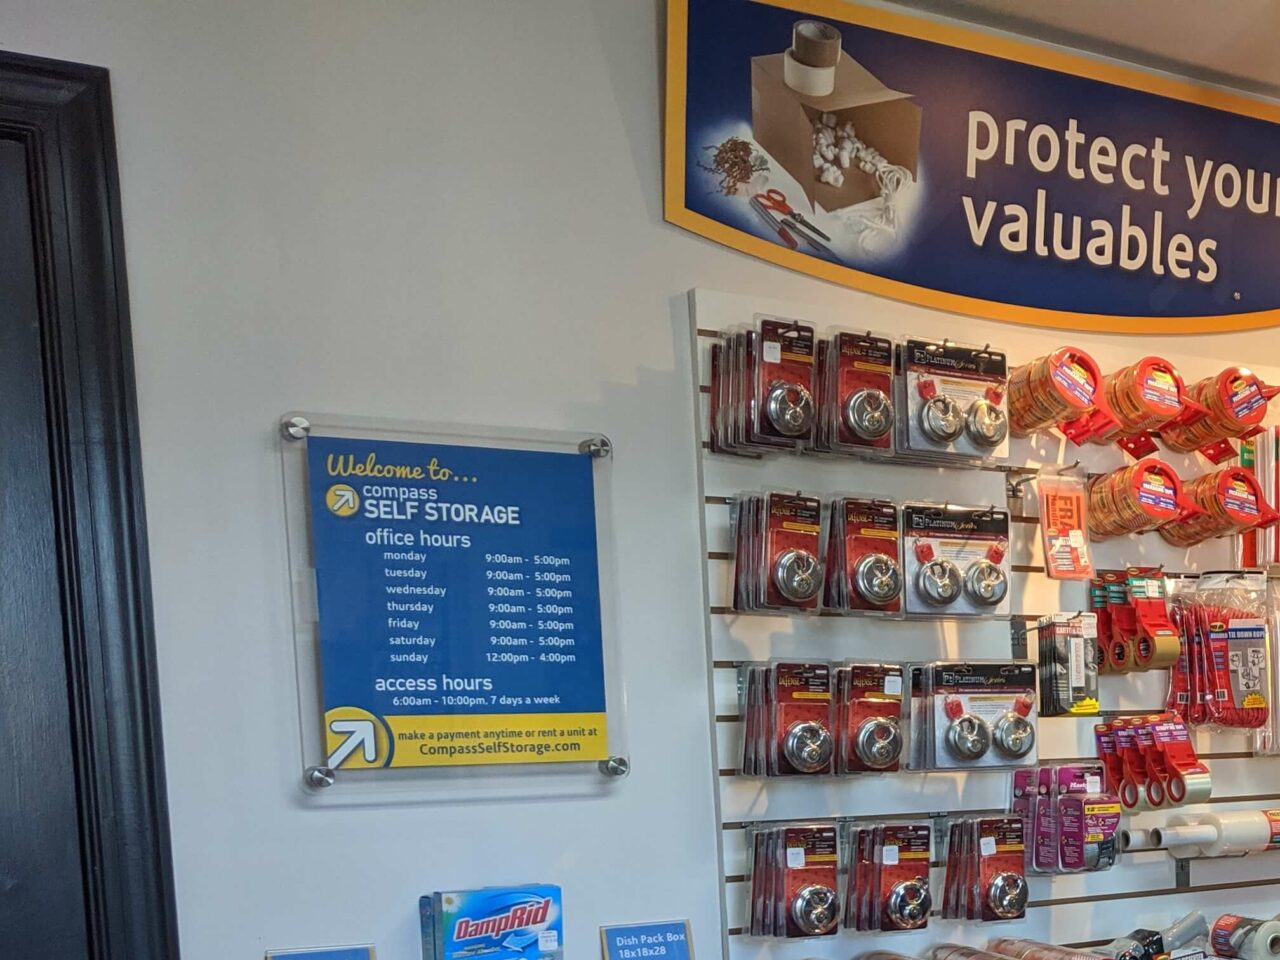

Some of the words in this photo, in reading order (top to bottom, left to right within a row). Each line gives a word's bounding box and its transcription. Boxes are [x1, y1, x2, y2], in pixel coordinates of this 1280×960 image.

[967, 109, 1169, 195] protect
[963, 189, 1219, 283] valuables
[327, 453, 425, 477] Welcome
[363, 485, 438, 502] compass
[365, 500, 418, 520] SELF
[425, 503, 520, 524] STORAGE
[365, 529, 414, 545] office
[420, 530, 471, 547] hours
[384, 552, 426, 563] monday
[485, 554, 523, 564] 9:00am
[534, 555, 570, 566] 5:00pm
[385, 568, 427, 579] tuesday
[487, 571, 523, 581] 9:00am
[535, 572, 571, 583] 5:00pm
[386, 585, 446, 596] wednesday
[487, 587, 524, 597] 9:00am
[536, 588, 572, 599] 5:00pm
[387, 602, 434, 613] thursday
[489, 604, 526, 614] 9:00am
[537, 604, 573, 615] 5:00pm
[388, 618, 419, 630] friday
[489, 620, 527, 630] 9:00am
[538, 621, 574, 631] 5:00pm
[389, 635, 436, 647] saturday
[490, 636, 528, 646] 9:00am
[539, 637, 575, 647] 5:00pm
[390, 653, 428, 664] sunday
[486, 653, 528, 663] 12:00pm
[539, 653, 576, 663] 4:00pm
[375, 678, 437, 691] access
[443, 675, 493, 691] hours
[393, 696, 432, 706] 6:00am
[491, 696, 496, 705] 7
[500, 696, 522, 707] days
[534, 695, 560, 704] week
[398, 730, 423, 740] make
[427, 732, 433, 740] a
[437, 730, 480, 742] payment
[483, 728, 522, 740] anytime
[537, 728, 556, 737] rent
[567, 727, 585, 736] unit
[588, 727, 597, 735] at
[419, 742, 580, 757] CompassSelfStorage.com
[454, 899, 552, 940] DampRid
[616, 935, 637, 946] Dish
[641, 934, 664, 945] Pack
[666, 932, 686, 942] Box
[618, 946, 666, 958] 18x18x28
